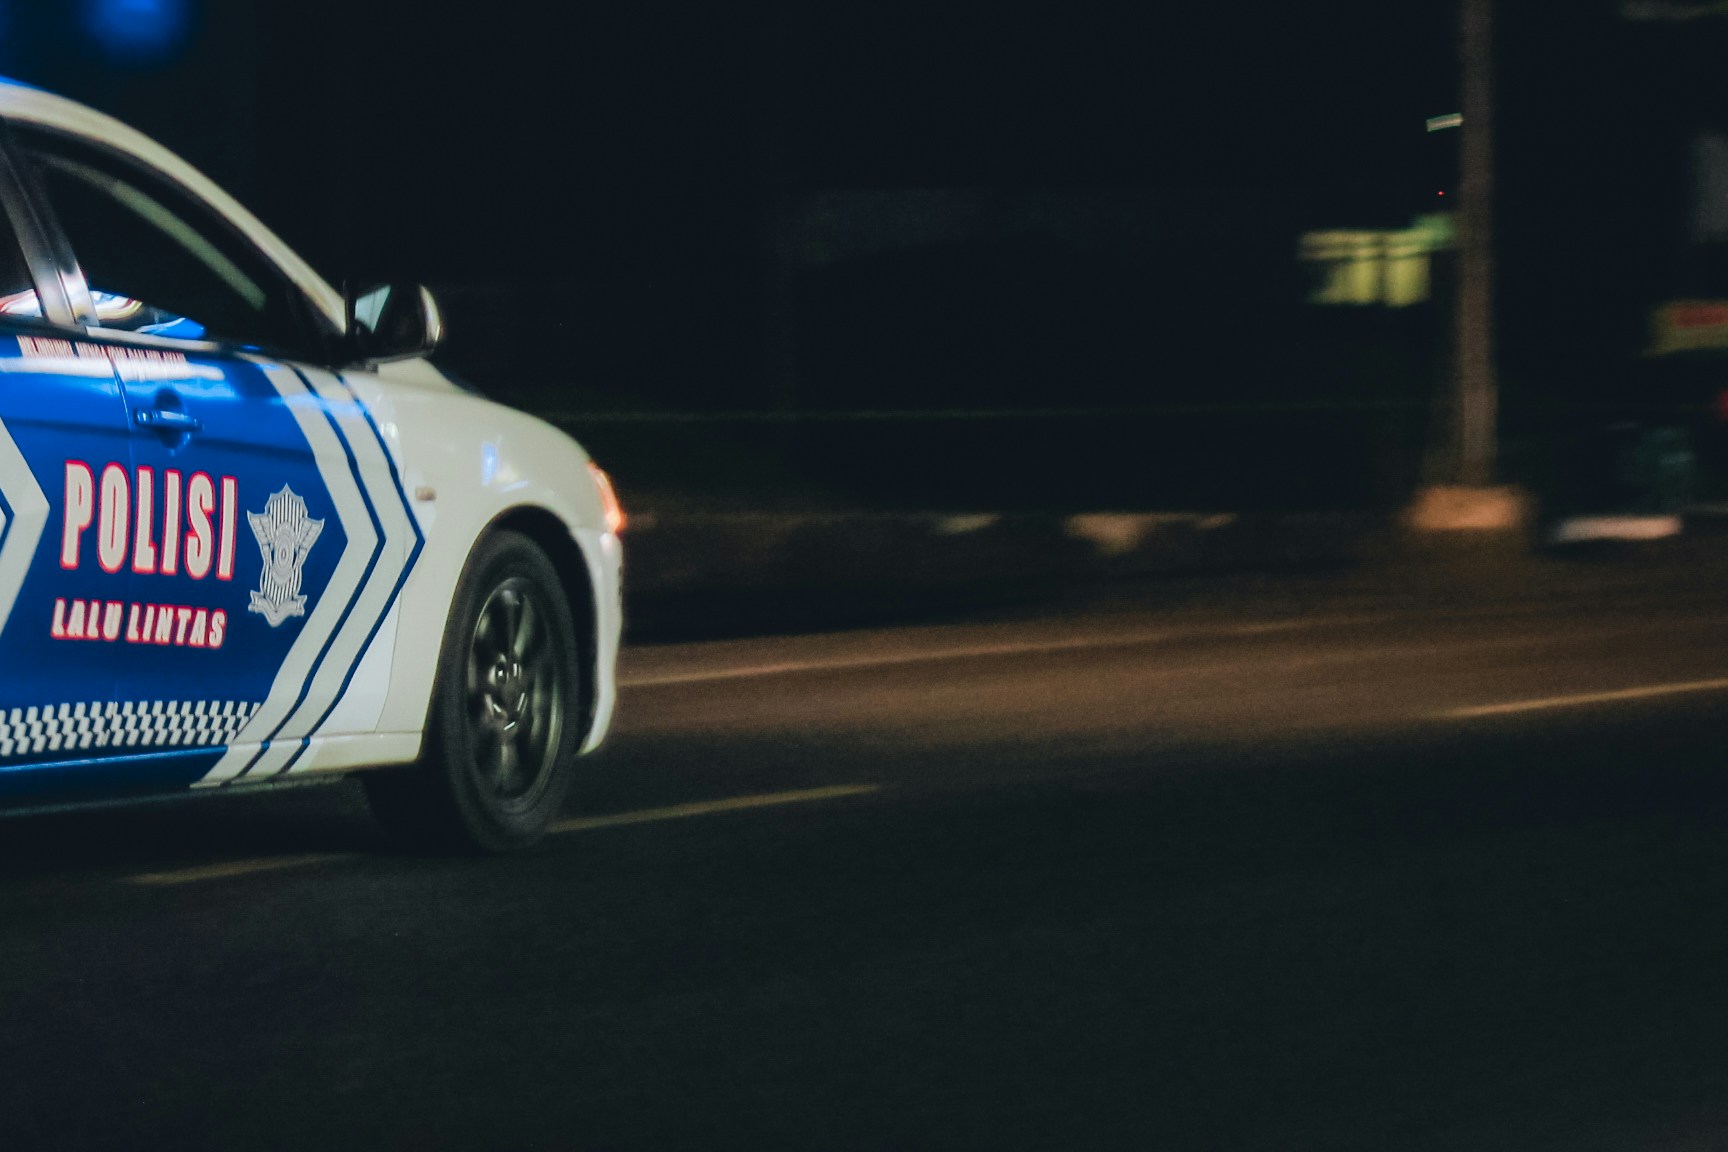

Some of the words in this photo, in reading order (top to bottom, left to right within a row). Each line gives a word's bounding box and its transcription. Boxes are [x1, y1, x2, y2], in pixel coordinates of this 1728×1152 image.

[60, 459, 239, 581] POLISI
[50, 597, 124, 641] LALU
[125, 601, 228, 649] LINTAS
